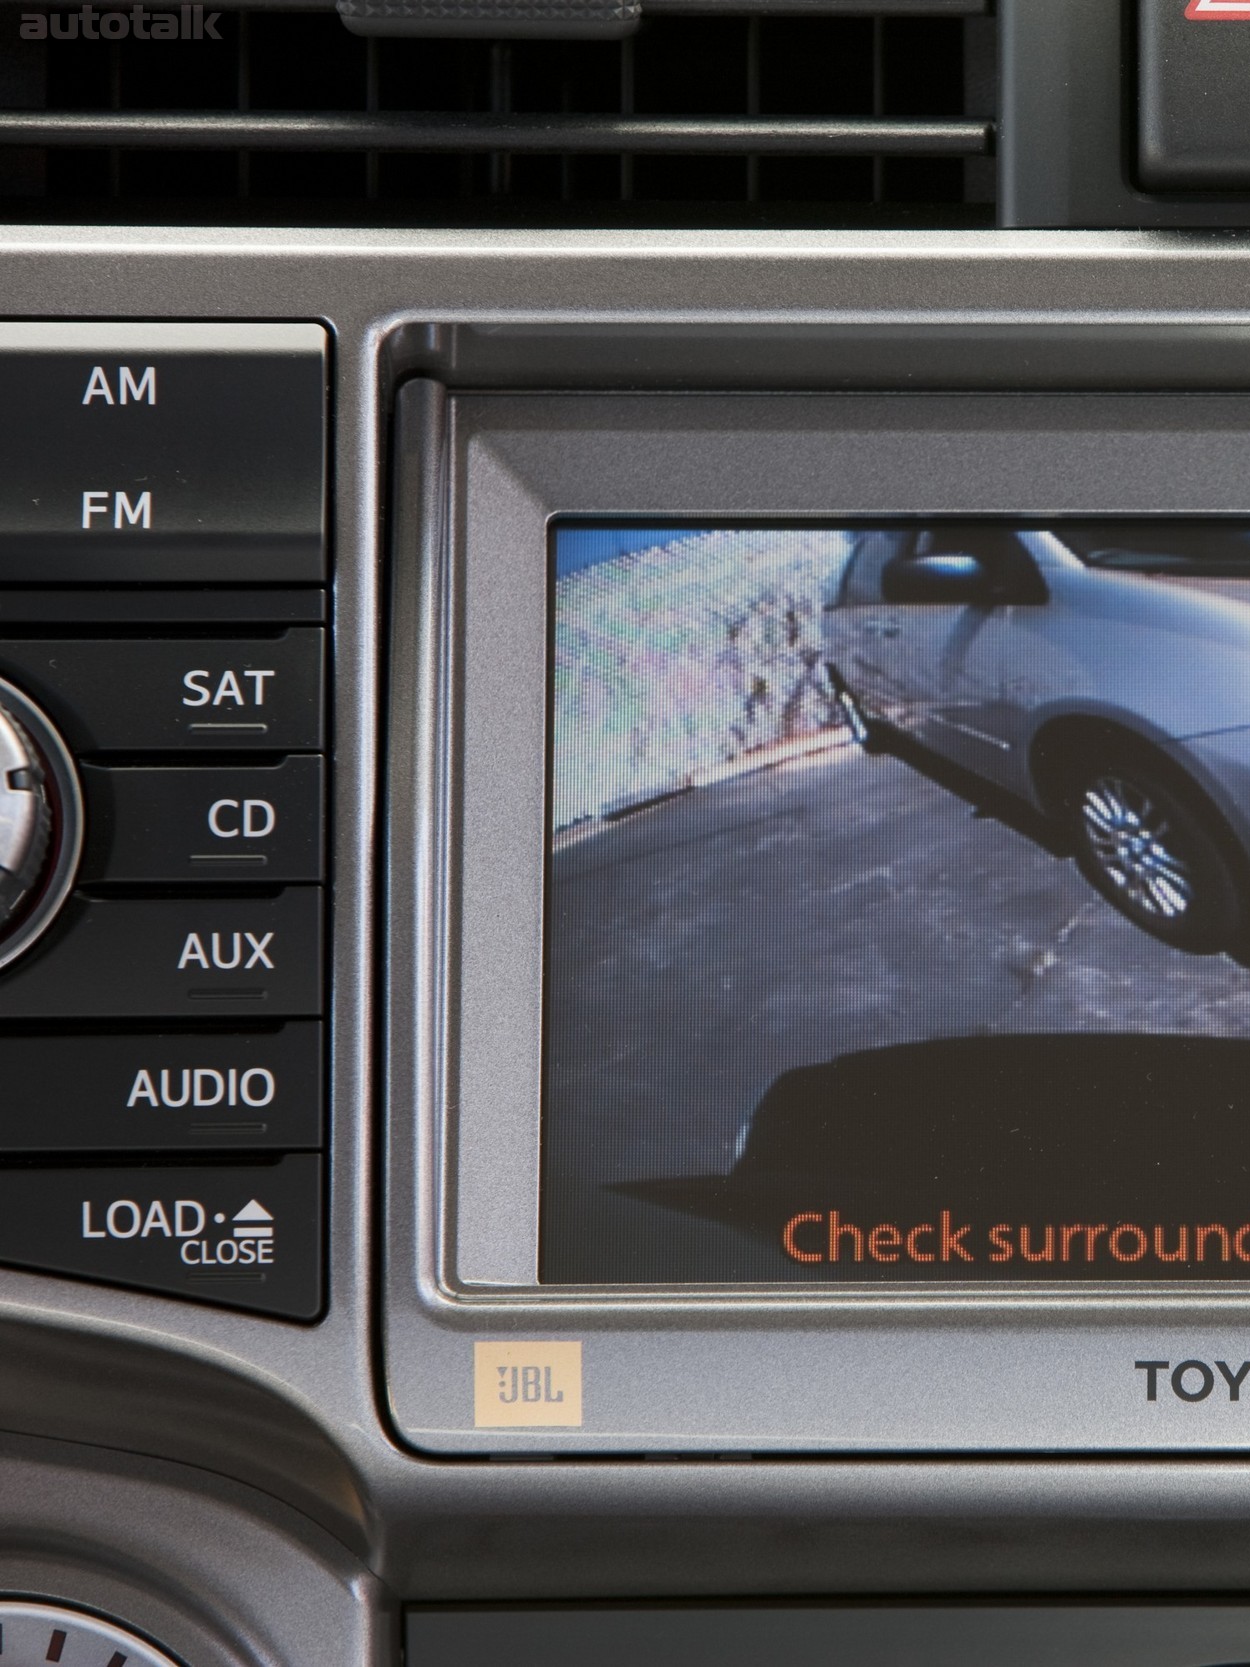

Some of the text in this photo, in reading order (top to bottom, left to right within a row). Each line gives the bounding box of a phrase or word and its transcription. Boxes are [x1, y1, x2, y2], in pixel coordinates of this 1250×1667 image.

[82, 366, 157, 405] AM
[81, 491, 152, 529] FM
[182, 670, 276, 706] SAT
[207, 799, 276, 838] CD
[177, 932, 275, 969] AUX
[126, 1068, 275, 1107] AUDIO
[81, 1200, 206, 1238] LOAD
[782, 1211, 974, 1263] Check
[180, 1240, 274, 1265] CLOSE
[496, 1366, 564, 1403] JBL
